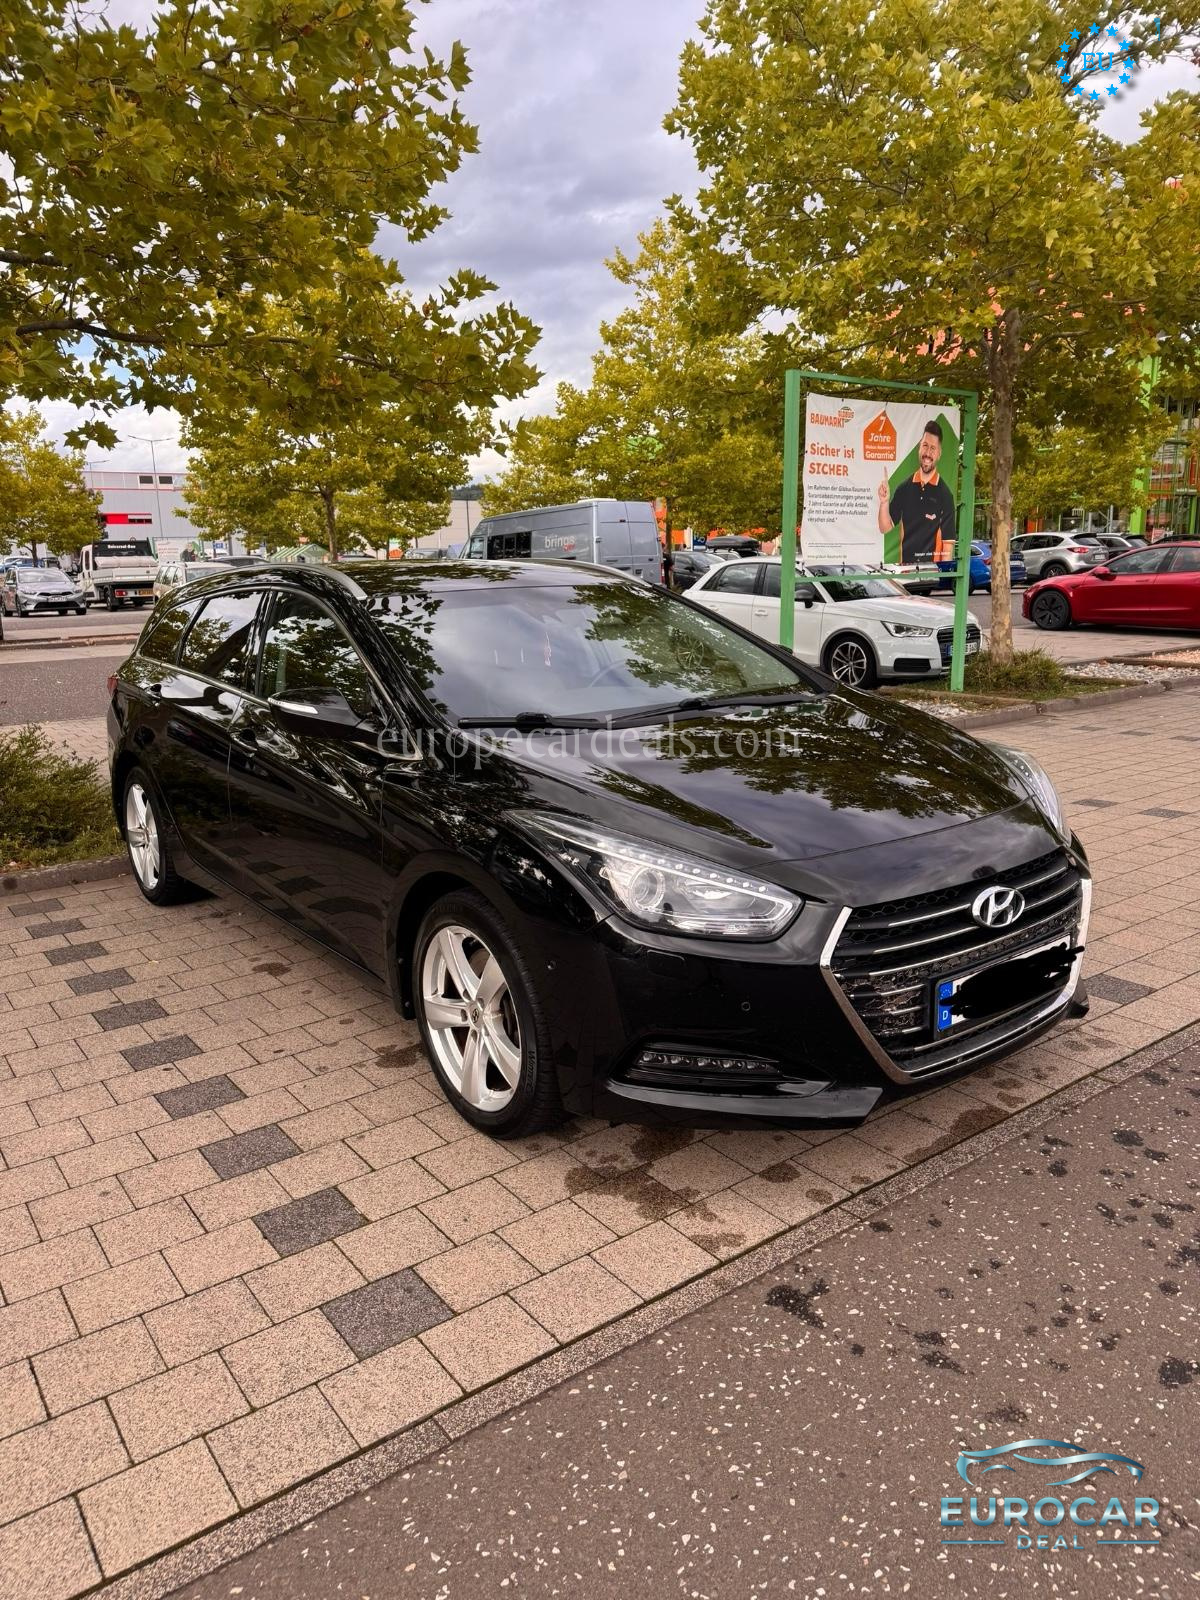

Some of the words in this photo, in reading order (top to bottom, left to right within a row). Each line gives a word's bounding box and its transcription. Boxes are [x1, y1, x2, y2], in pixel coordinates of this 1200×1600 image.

[810, 412, 844, 428] BAUMARKT
[879, 416, 886, 431] 7
[868, 433, 891, 442] Jahre
[810, 442, 840, 457] Sicher
[843, 445, 855, 459] ist
[809, 462, 849, 476] SICHER
[943, 1010, 949, 1020] D
